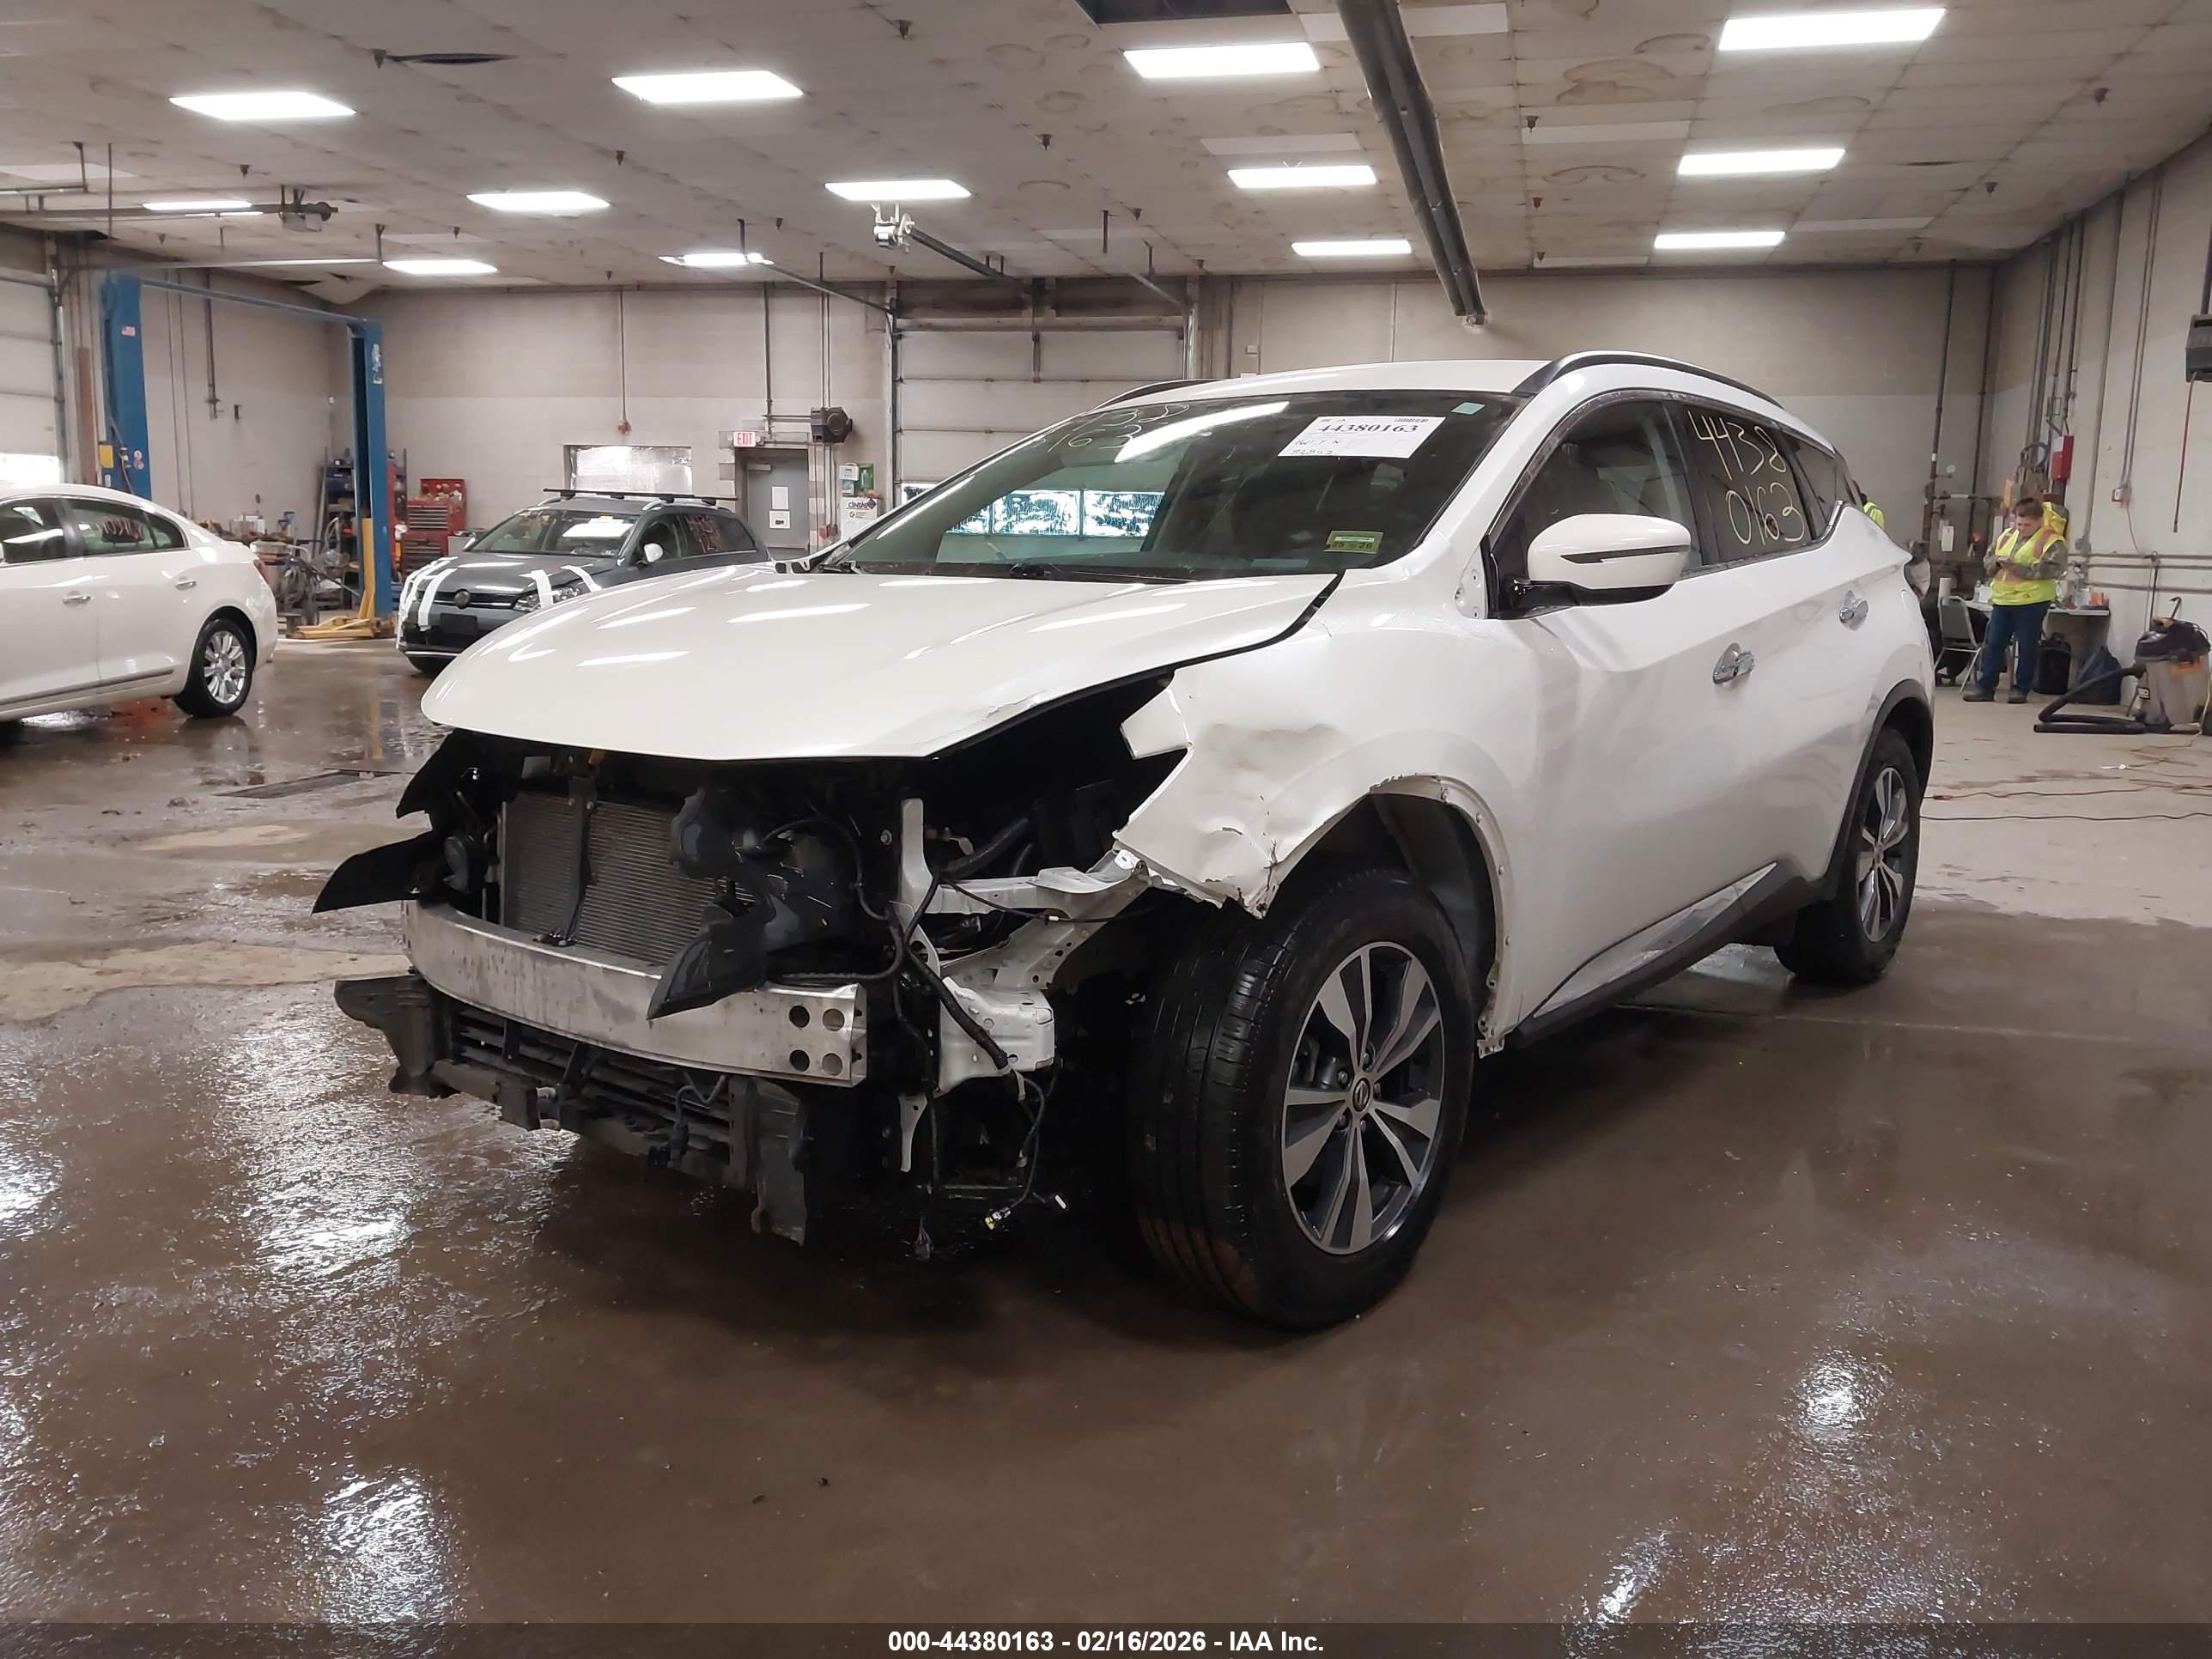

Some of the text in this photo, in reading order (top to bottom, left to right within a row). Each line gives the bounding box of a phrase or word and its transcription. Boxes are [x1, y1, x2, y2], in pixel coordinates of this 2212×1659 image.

[738, 432, 752, 445] EXIT
[1318, 424, 1419, 433] 44380163
[1687, 410, 1787, 480] 4438
[1726, 482, 1805, 545] 0163
